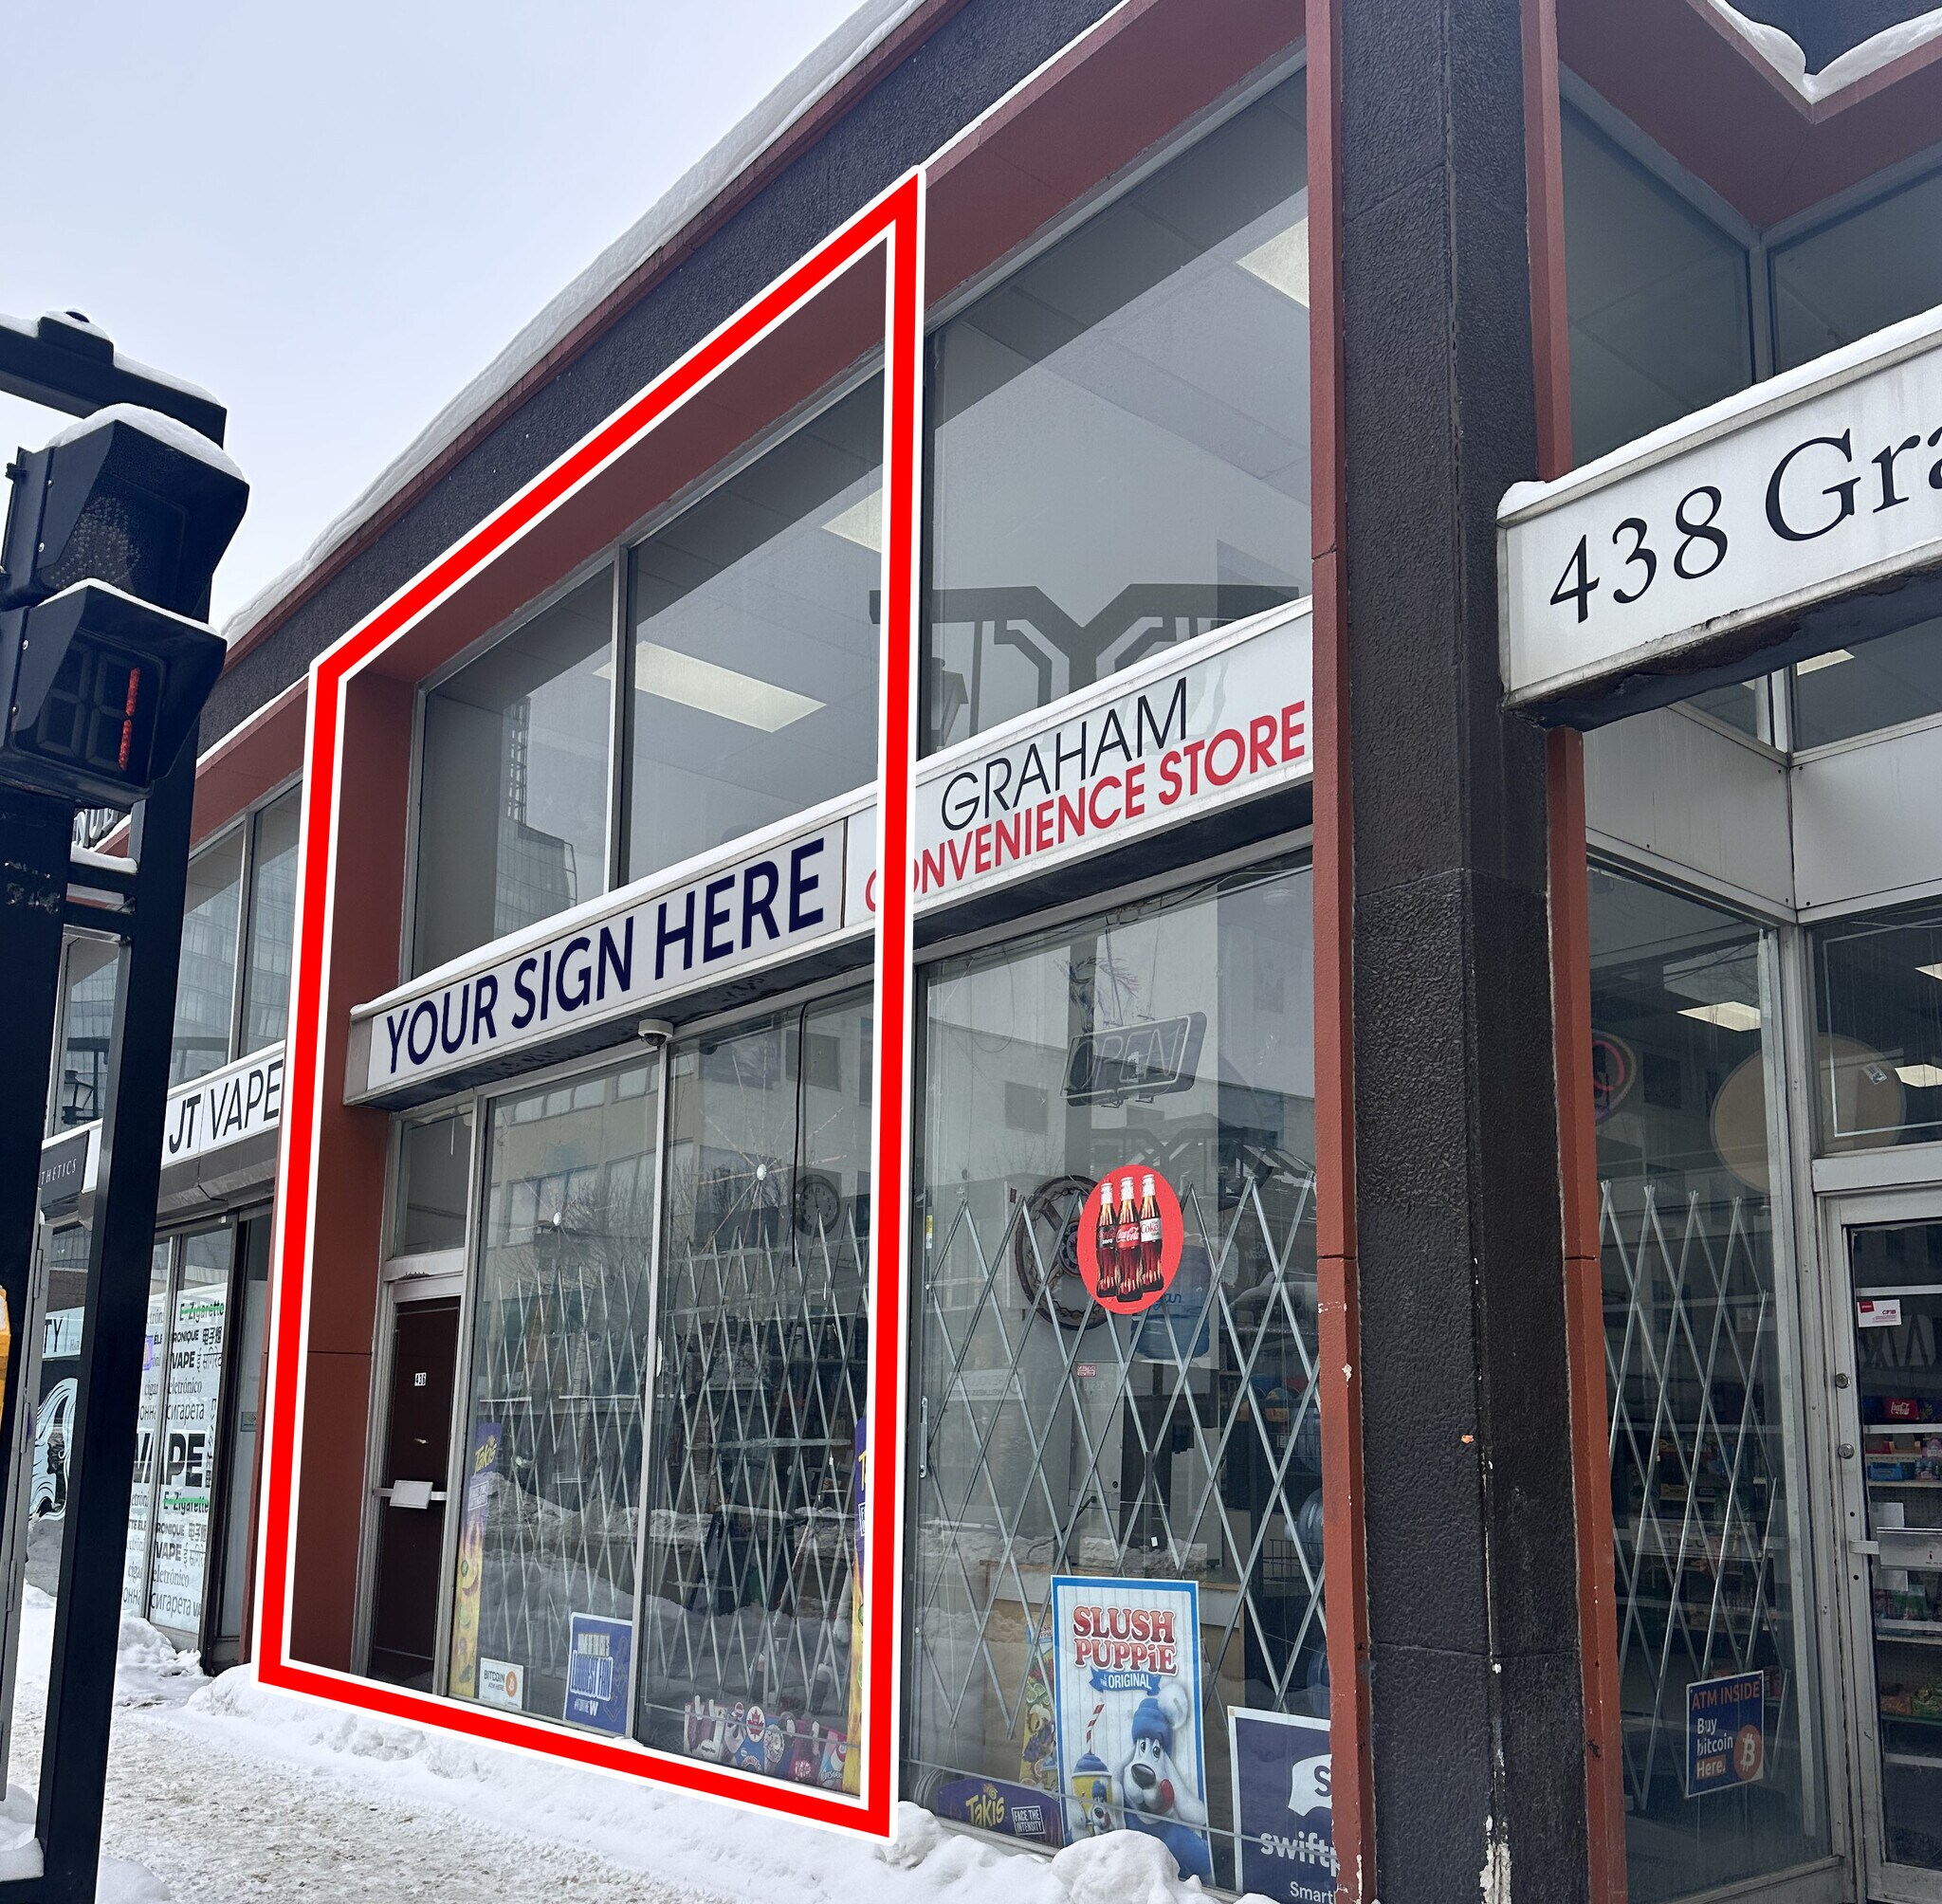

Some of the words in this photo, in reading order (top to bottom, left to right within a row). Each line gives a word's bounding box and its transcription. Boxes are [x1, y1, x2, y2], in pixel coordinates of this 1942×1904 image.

[1549, 485, 1729, 624] 438
[941, 676, 1187, 832] GRAHAM
[865, 763, 1145, 913] NVENIENCE
[1159, 700, 1306, 805] STORE
[385, 974, 499, 1074] YOUR
[510, 916, 634, 1029] SIGN
[653, 837, 825, 980] HERE
[168, 1093, 202, 1154] JT
[210, 1058, 284, 1141] VAPE
[1072, 1605, 1176, 1643] SLUSH
[1108, 1674, 1152, 1690] ORIGINAL
[1691, 1689, 1717, 1711] ATM
[1720, 1681, 1760, 1705] INSIDE
[1697, 1717, 1717, 1736] Buy
[1696, 1732, 1733, 1756] bitcoin
[1696, 1760, 1726, 1780] Here.
[1014, 1810, 1028, 1822] FACE
[1028, 1808, 1040, 1821] THE
[1016, 1821, 1042, 1833] INTENSITY
